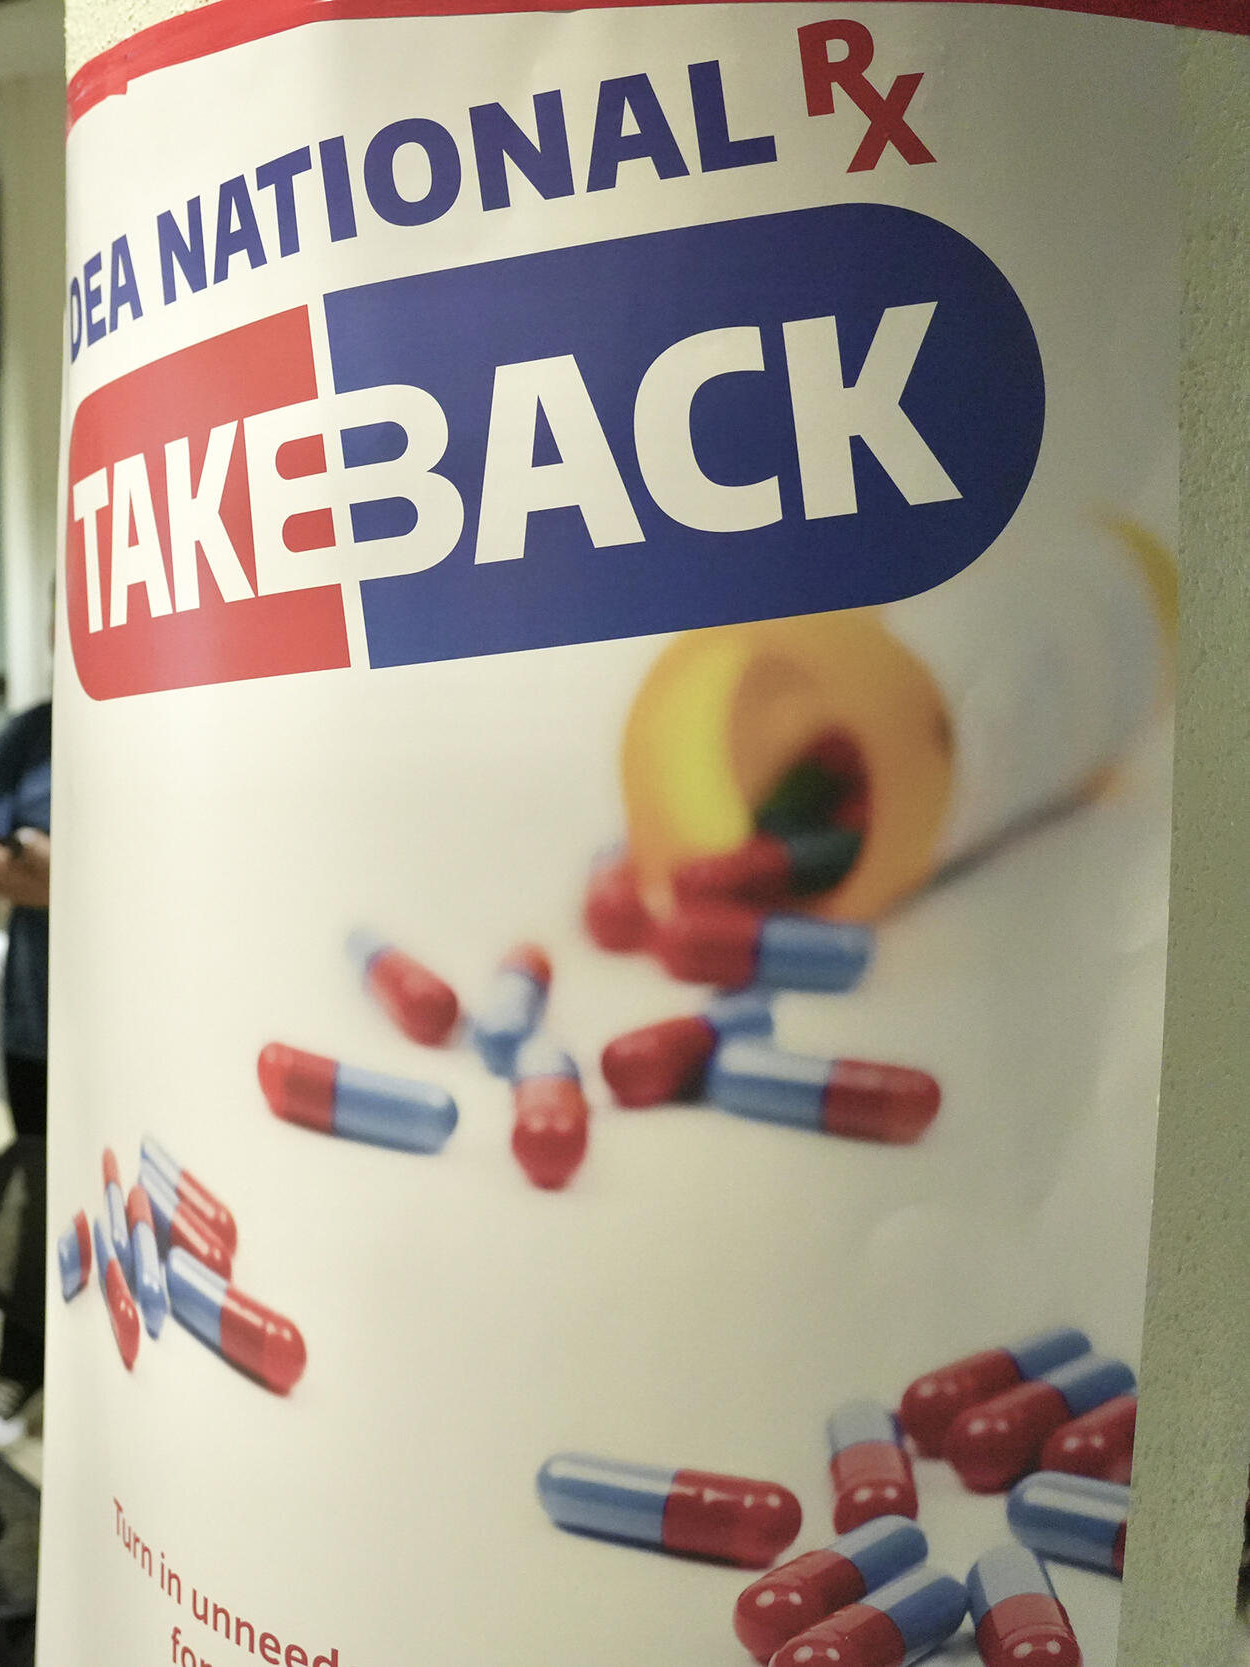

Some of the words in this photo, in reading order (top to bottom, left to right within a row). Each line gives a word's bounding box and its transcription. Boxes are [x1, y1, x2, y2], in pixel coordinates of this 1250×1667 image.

[70, 234, 143, 364] DEA
[156, 60, 777, 307] NATIONAL
[113, 1496, 152, 1577] Turn
[160, 1552, 181, 1605] in
[171, 1626, 213, 1667] fo
